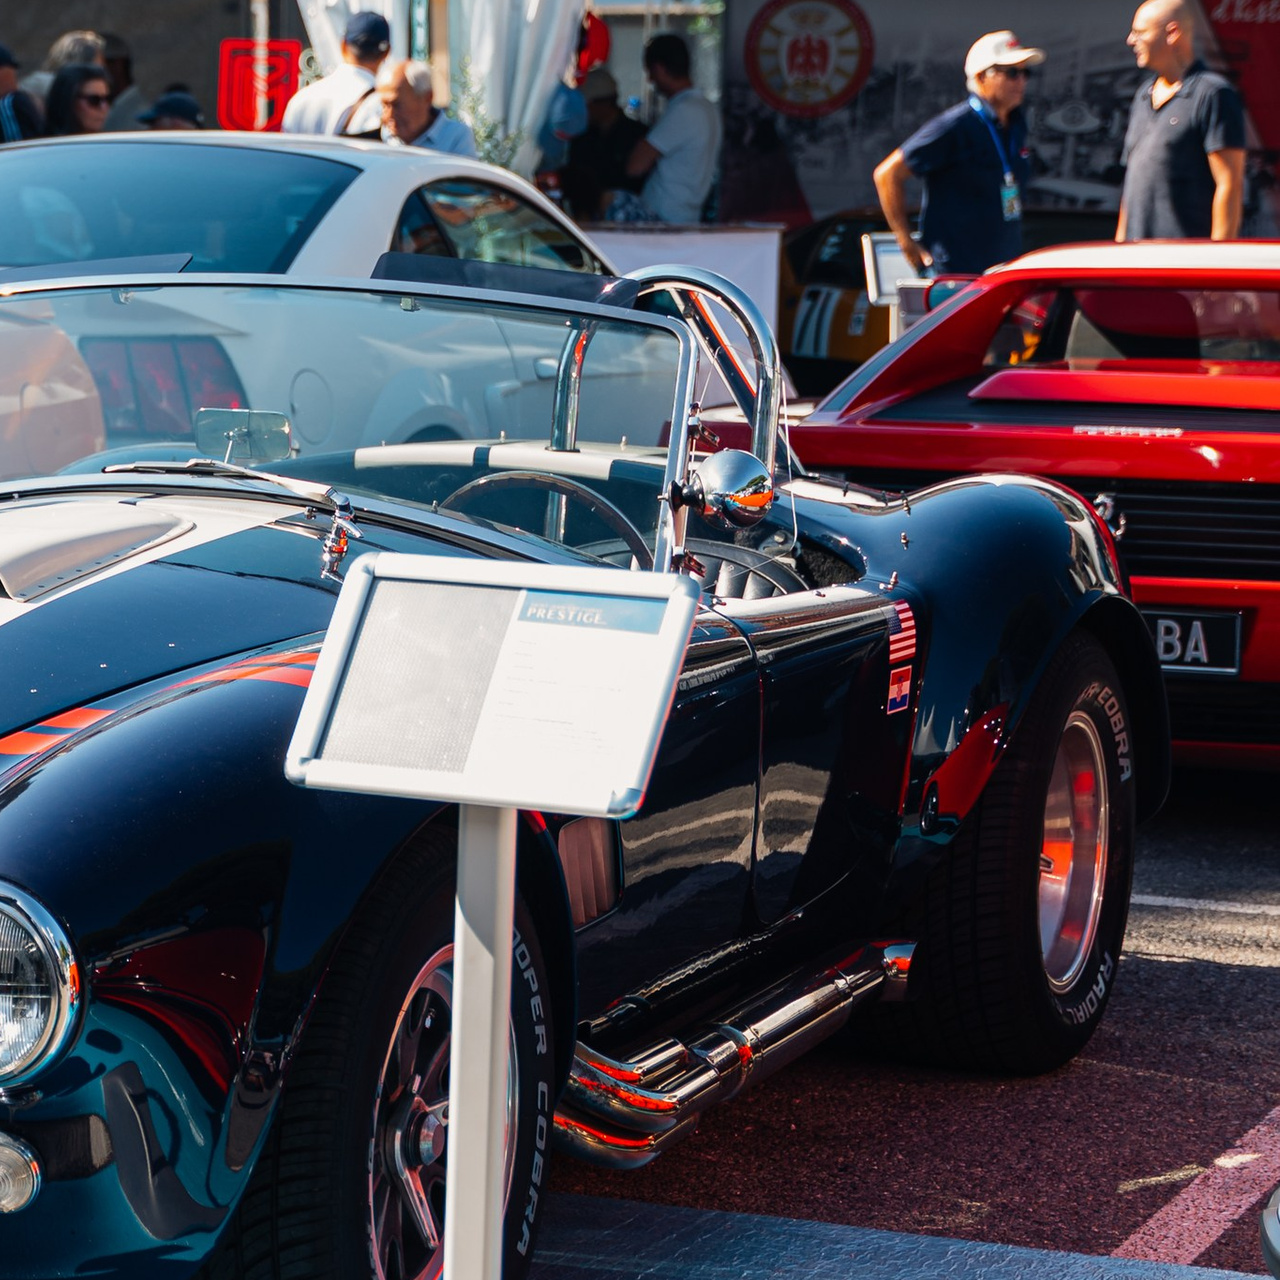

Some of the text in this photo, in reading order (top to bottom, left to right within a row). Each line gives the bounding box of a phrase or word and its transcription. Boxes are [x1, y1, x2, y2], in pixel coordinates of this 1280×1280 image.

[1096, 686, 1132, 783] COBRA
[1066, 950, 1114, 1024] RADIAL
[513, 926, 548, 1256] OPER COBRA
